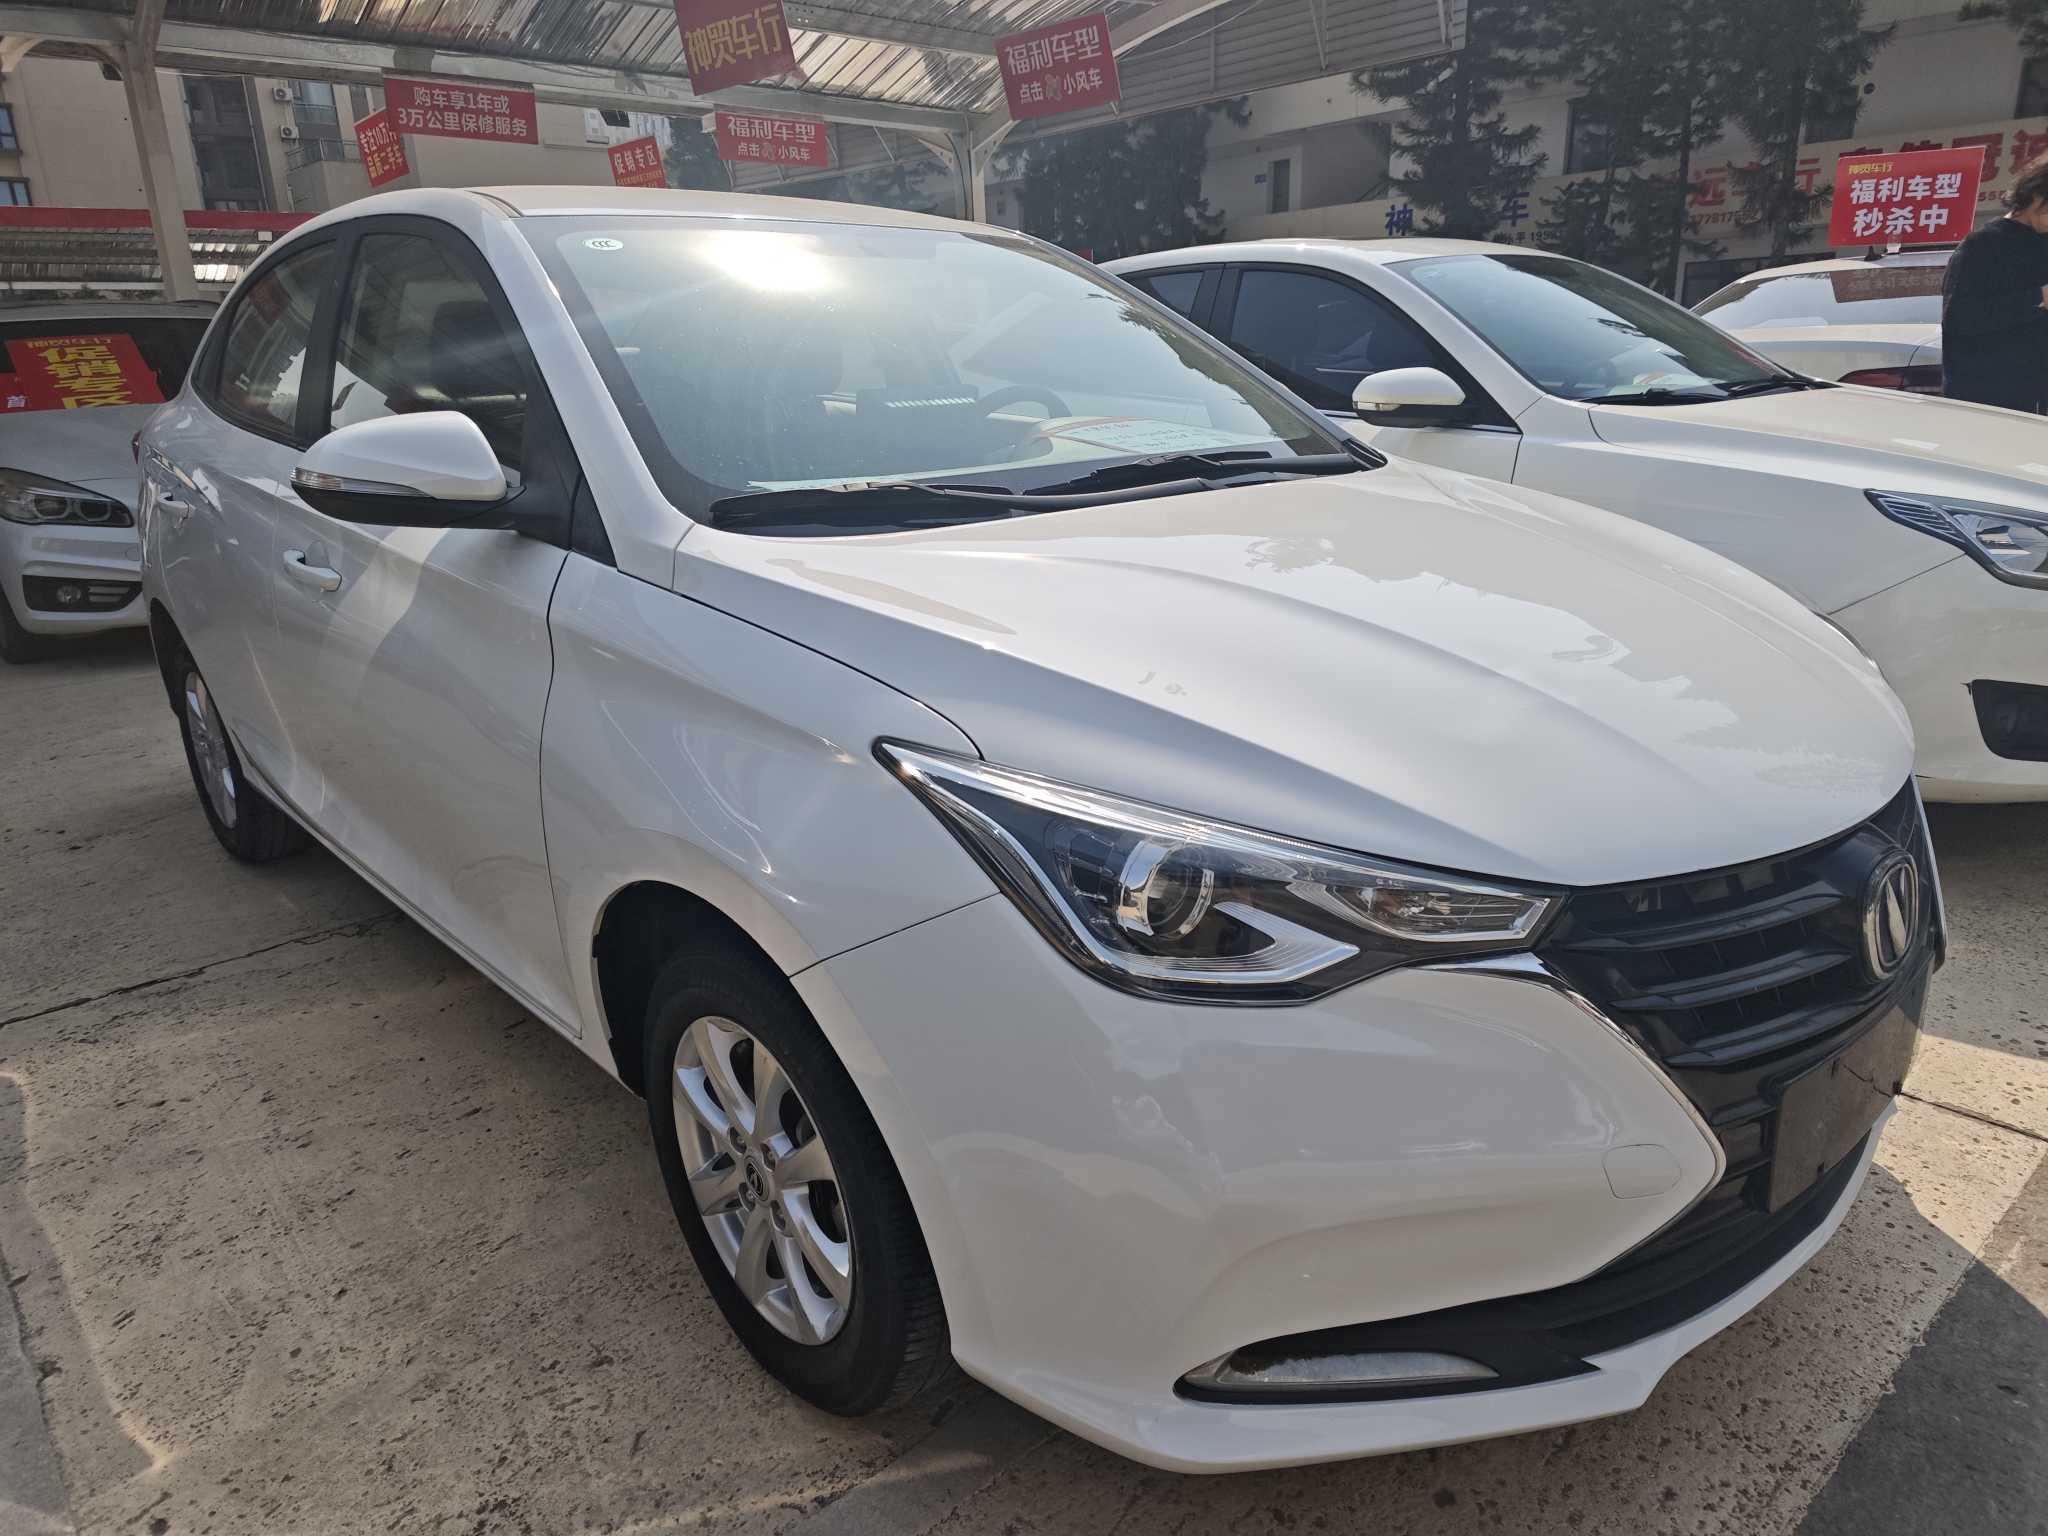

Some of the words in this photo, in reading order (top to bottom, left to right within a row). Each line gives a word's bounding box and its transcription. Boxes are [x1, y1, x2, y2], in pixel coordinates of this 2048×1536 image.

[1004, 24, 1103, 76] 福利车型
[413, 86, 511, 114] 购车享1年或
[1020, 81, 1044, 104] 点击
[1063, 67, 1103, 95] 小风车
[398, 107, 528, 137] 3万公里保修服务
[727, 115, 817, 145] 福利车型
[613, 144, 658, 176] 促销专区
[737, 141, 760, 158] 点击
[777, 145, 811, 161] 小风车
[1850, 172, 1963, 205] 福利车型
[1852, 203, 1949, 238] 秒杀中
